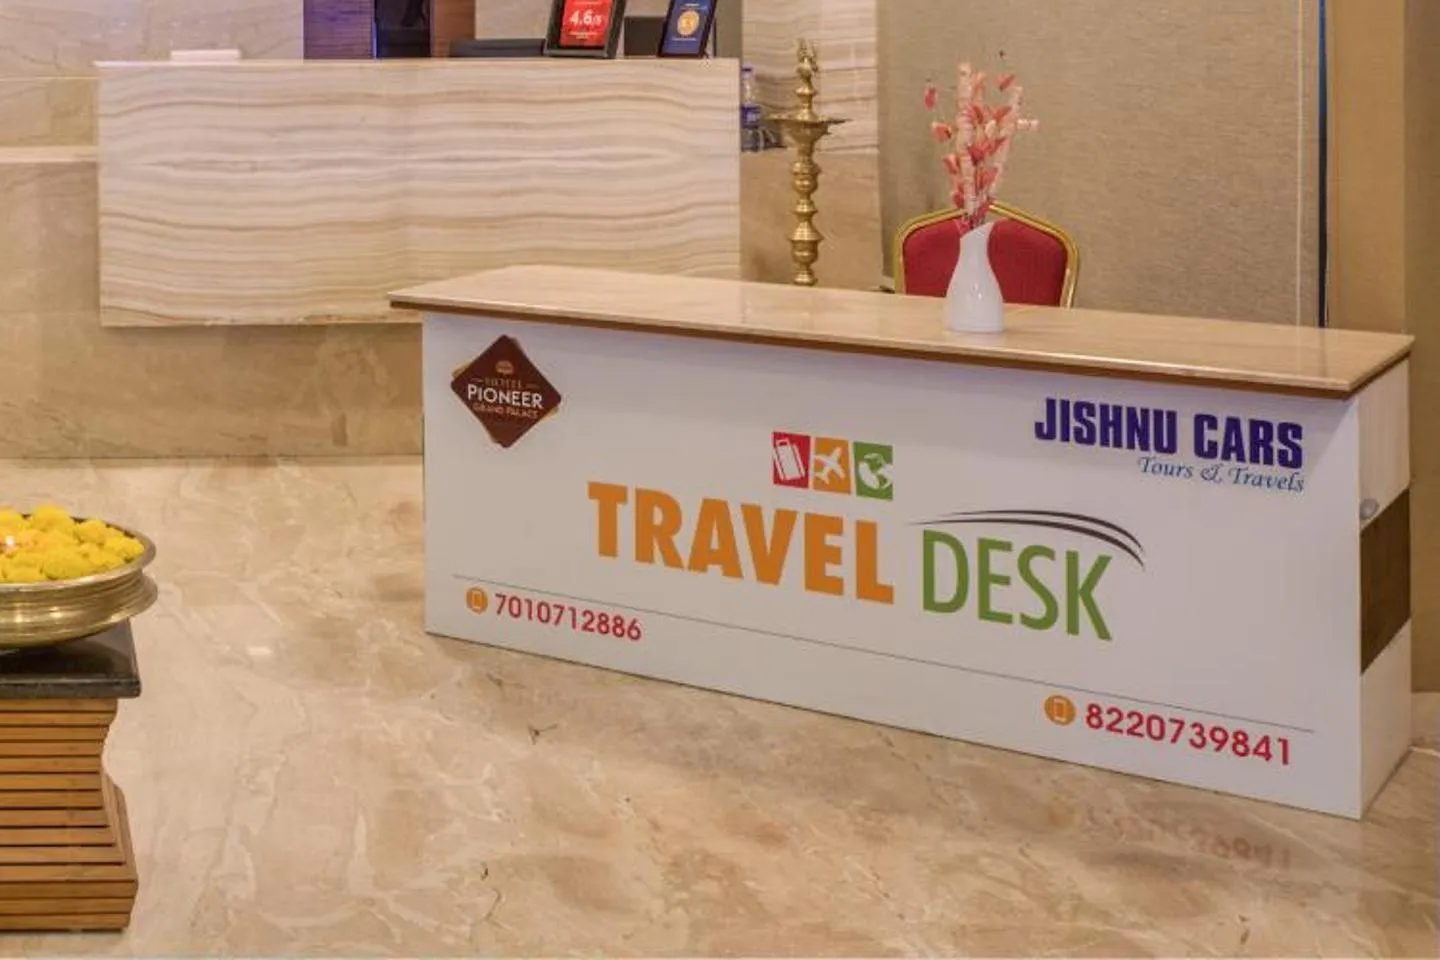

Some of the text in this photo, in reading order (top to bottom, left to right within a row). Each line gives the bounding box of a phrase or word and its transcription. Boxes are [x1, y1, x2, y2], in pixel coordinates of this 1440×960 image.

[467, 383, 544, 409] PIONEER
[1034, 396, 1303, 470] JISHNU CARS
[1138, 456, 1305, 493] Tours & Travels
[587, 481, 1113, 641] TRAVEL DESK
[495, 592, 642, 641] 7010712886
[1085, 702, 1290, 766] 8220739841
